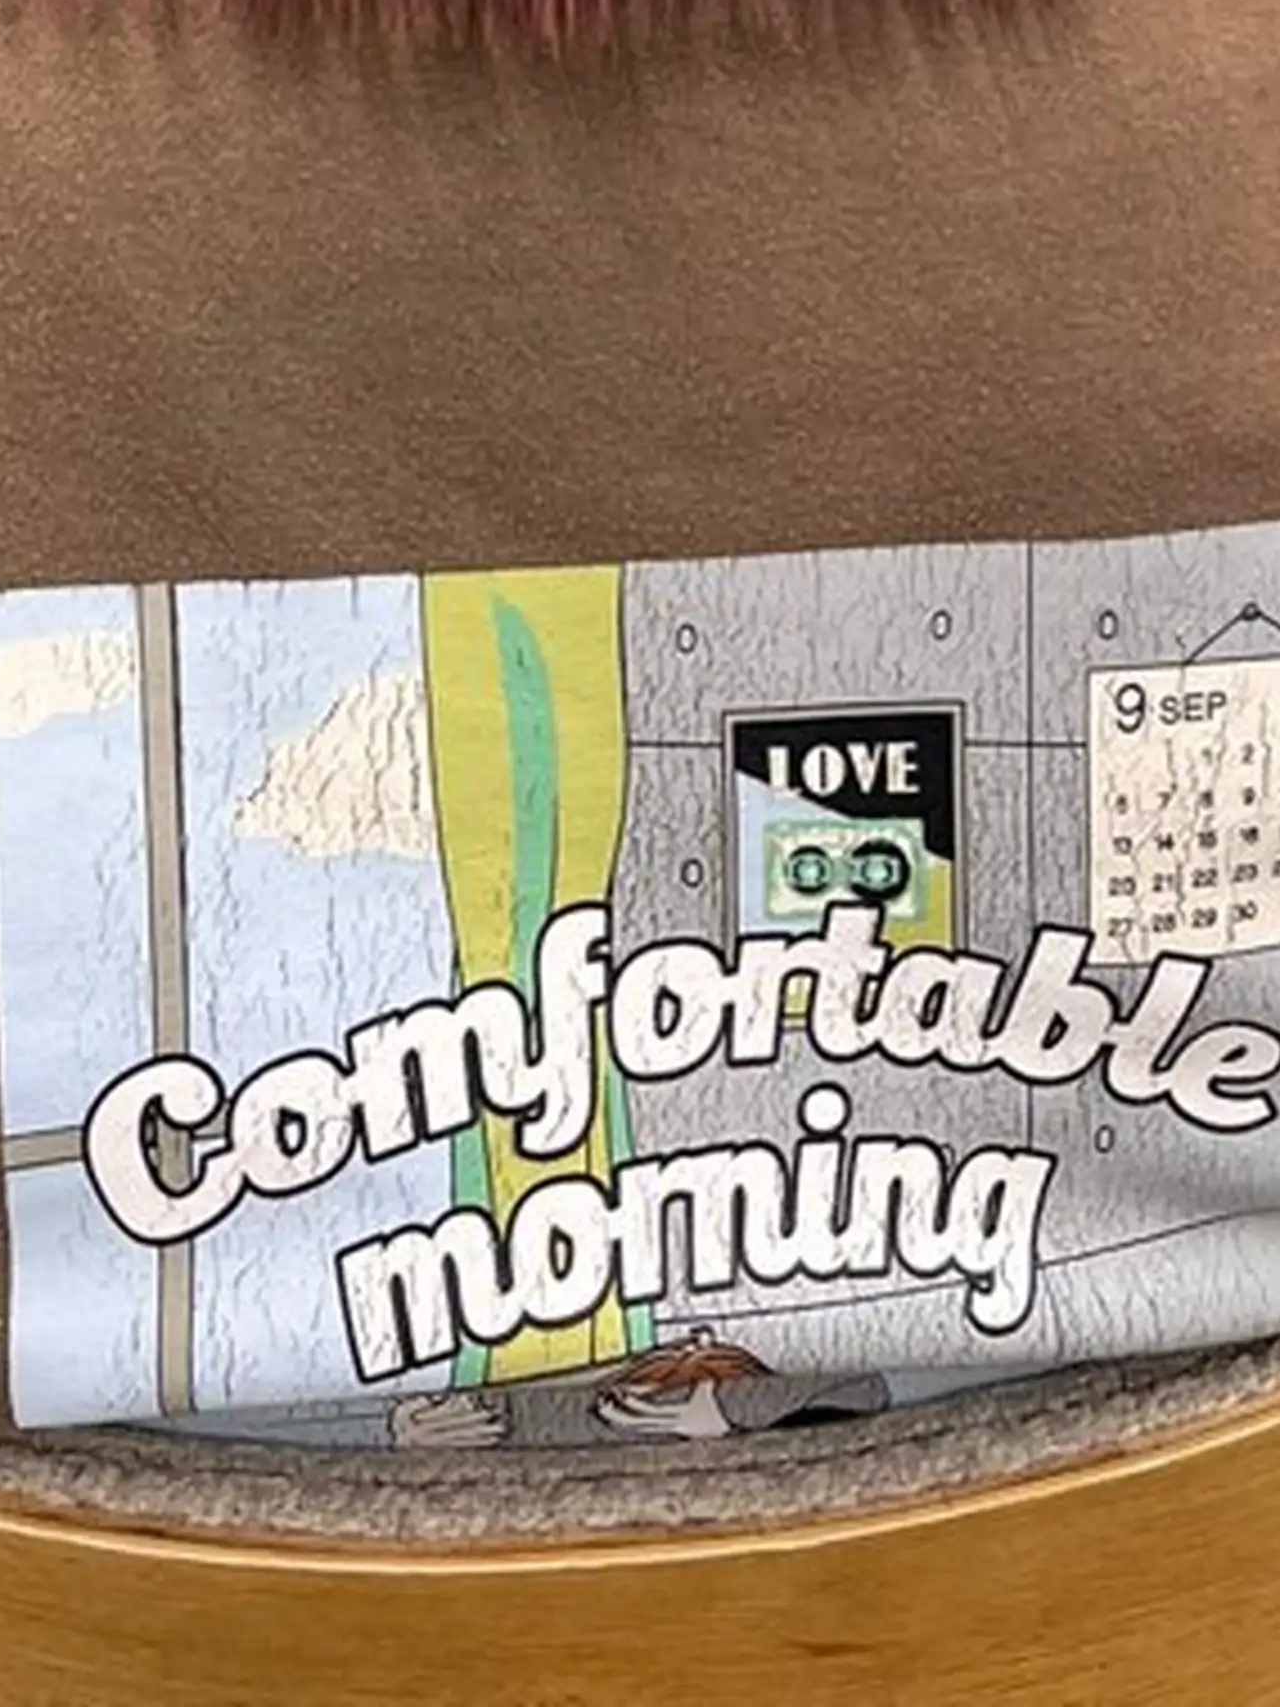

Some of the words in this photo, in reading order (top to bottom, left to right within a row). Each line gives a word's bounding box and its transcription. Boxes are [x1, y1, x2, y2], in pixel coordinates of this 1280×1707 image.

[1115, 683, 1146, 735] 9
[1159, 691, 1227, 726] SEP
[767, 741, 921, 798] LOVE
[336, 1083, 1056, 1383] morning
